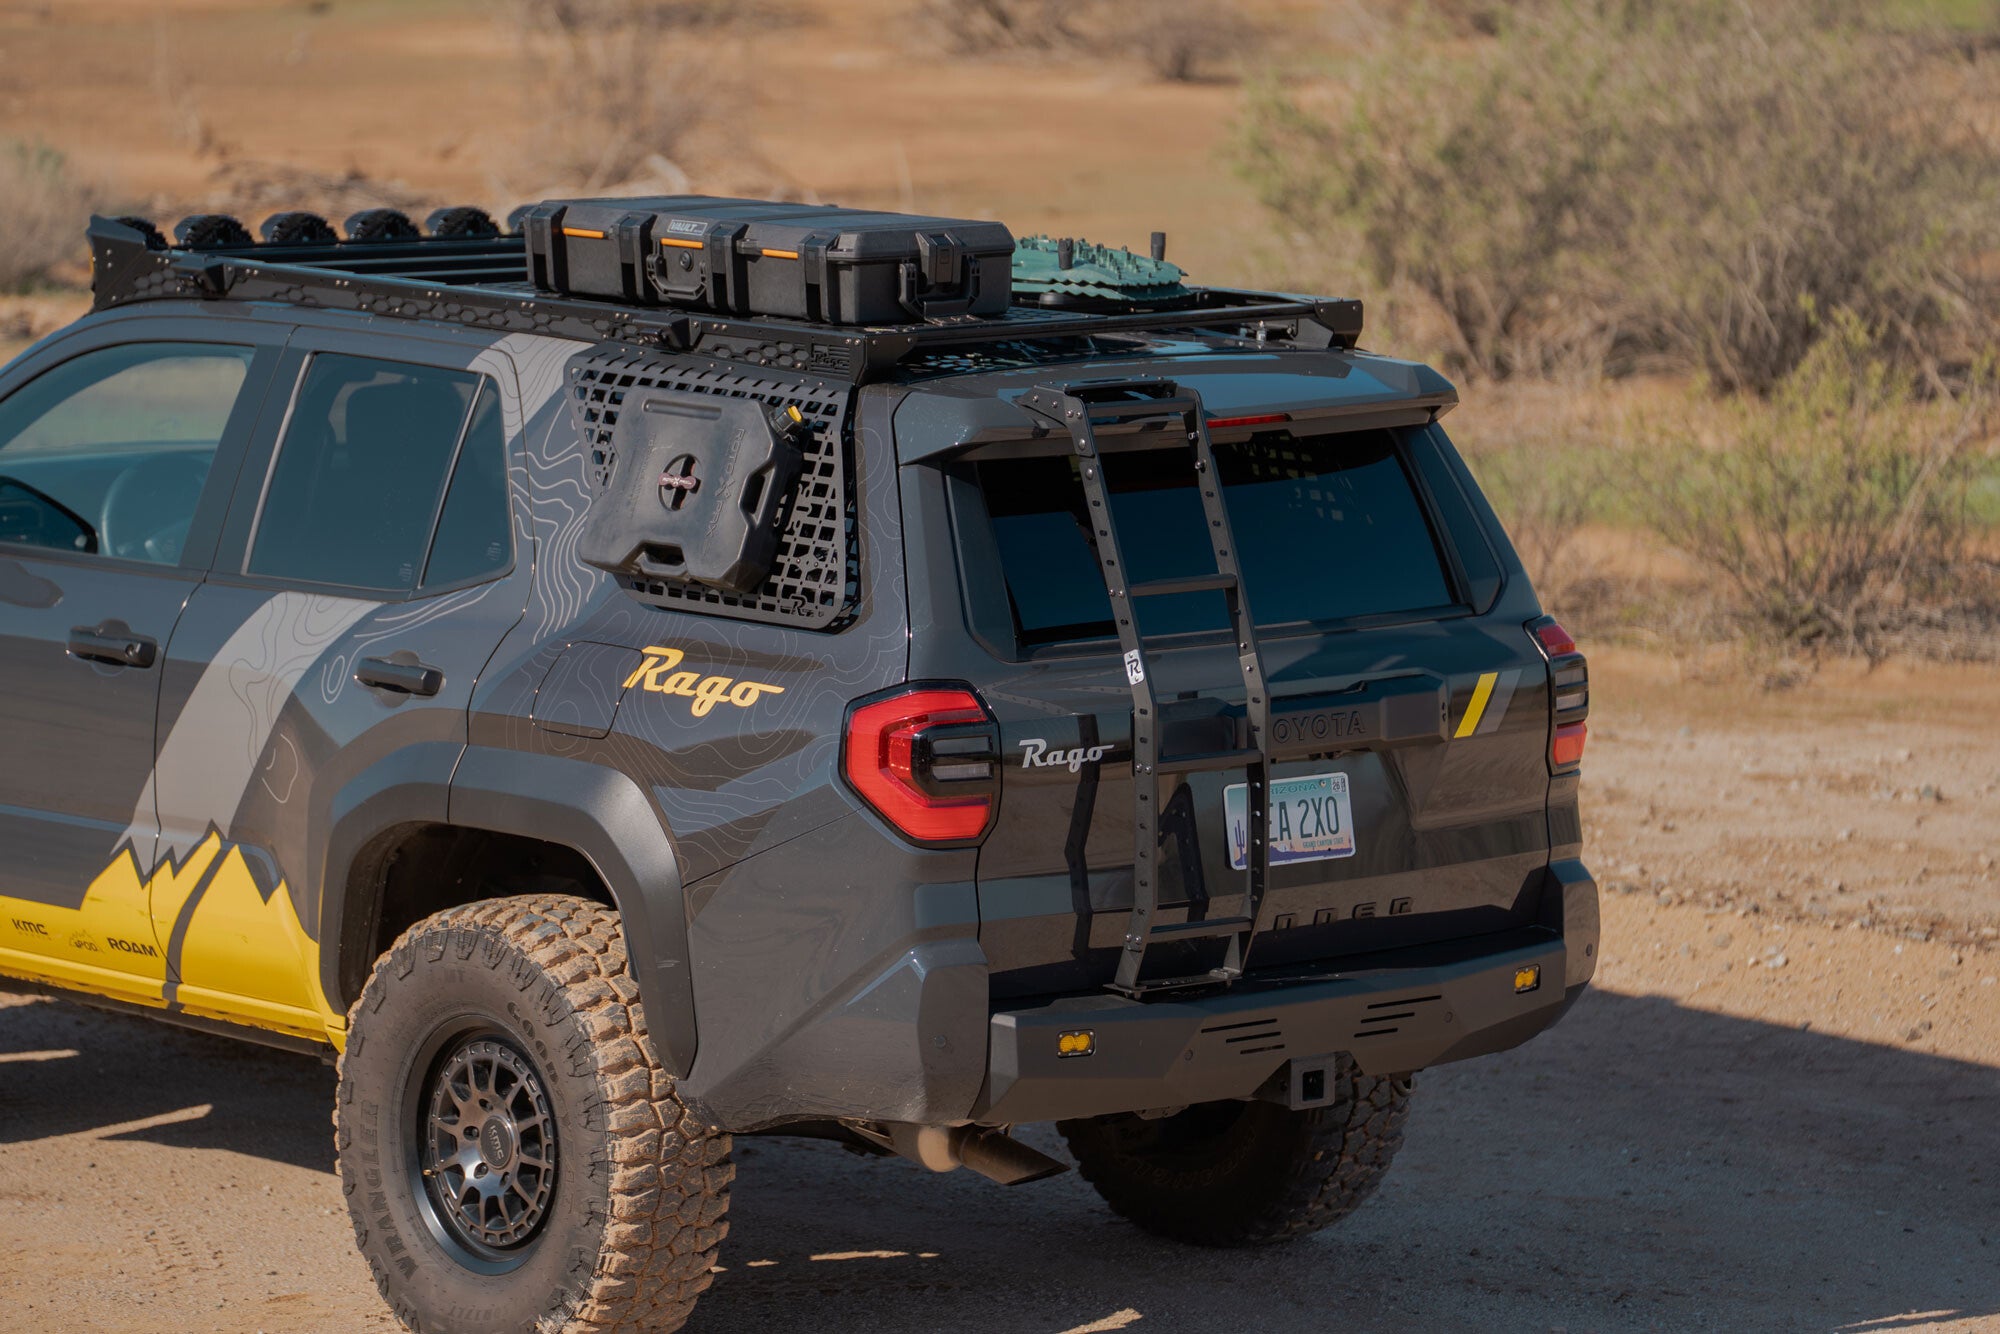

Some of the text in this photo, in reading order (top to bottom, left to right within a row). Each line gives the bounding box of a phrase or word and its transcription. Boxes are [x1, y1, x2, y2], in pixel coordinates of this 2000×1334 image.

[622, 645, 785, 718] Rago
[1127, 659, 1142, 677] R
[1272, 710, 1366, 743] OYOTA
[1018, 738, 1115, 773] Rago
[1270, 783, 1317, 795] RIZONA
[106, 937, 158, 957] ROAM
[360, 1101, 419, 1281] WRANGLER
